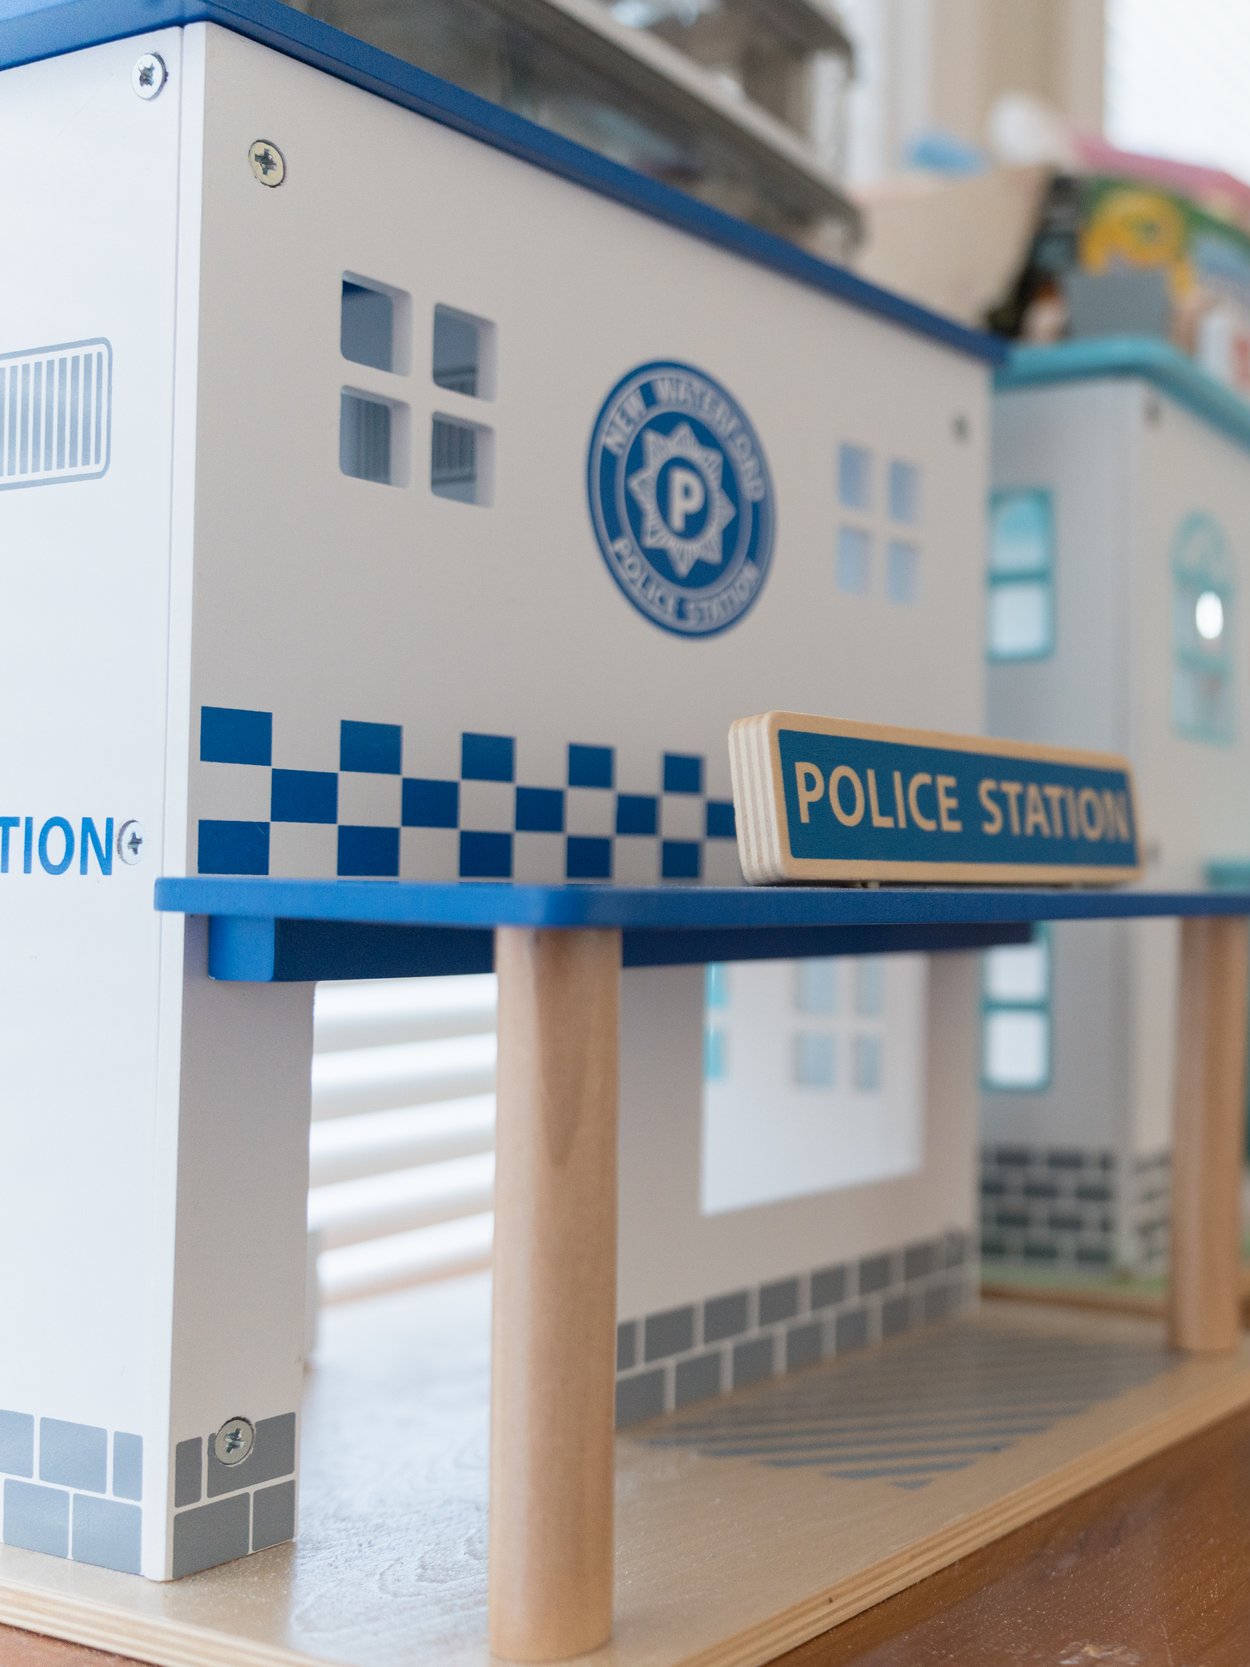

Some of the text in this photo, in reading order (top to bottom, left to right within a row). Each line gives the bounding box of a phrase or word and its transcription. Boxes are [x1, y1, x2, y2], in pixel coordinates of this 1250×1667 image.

[604, 384, 648, 456] NEW
[670, 466, 706, 533] P
[612, 537, 760, 625] POLICE STATION
[794, 761, 1131, 842] POLICE STATION
